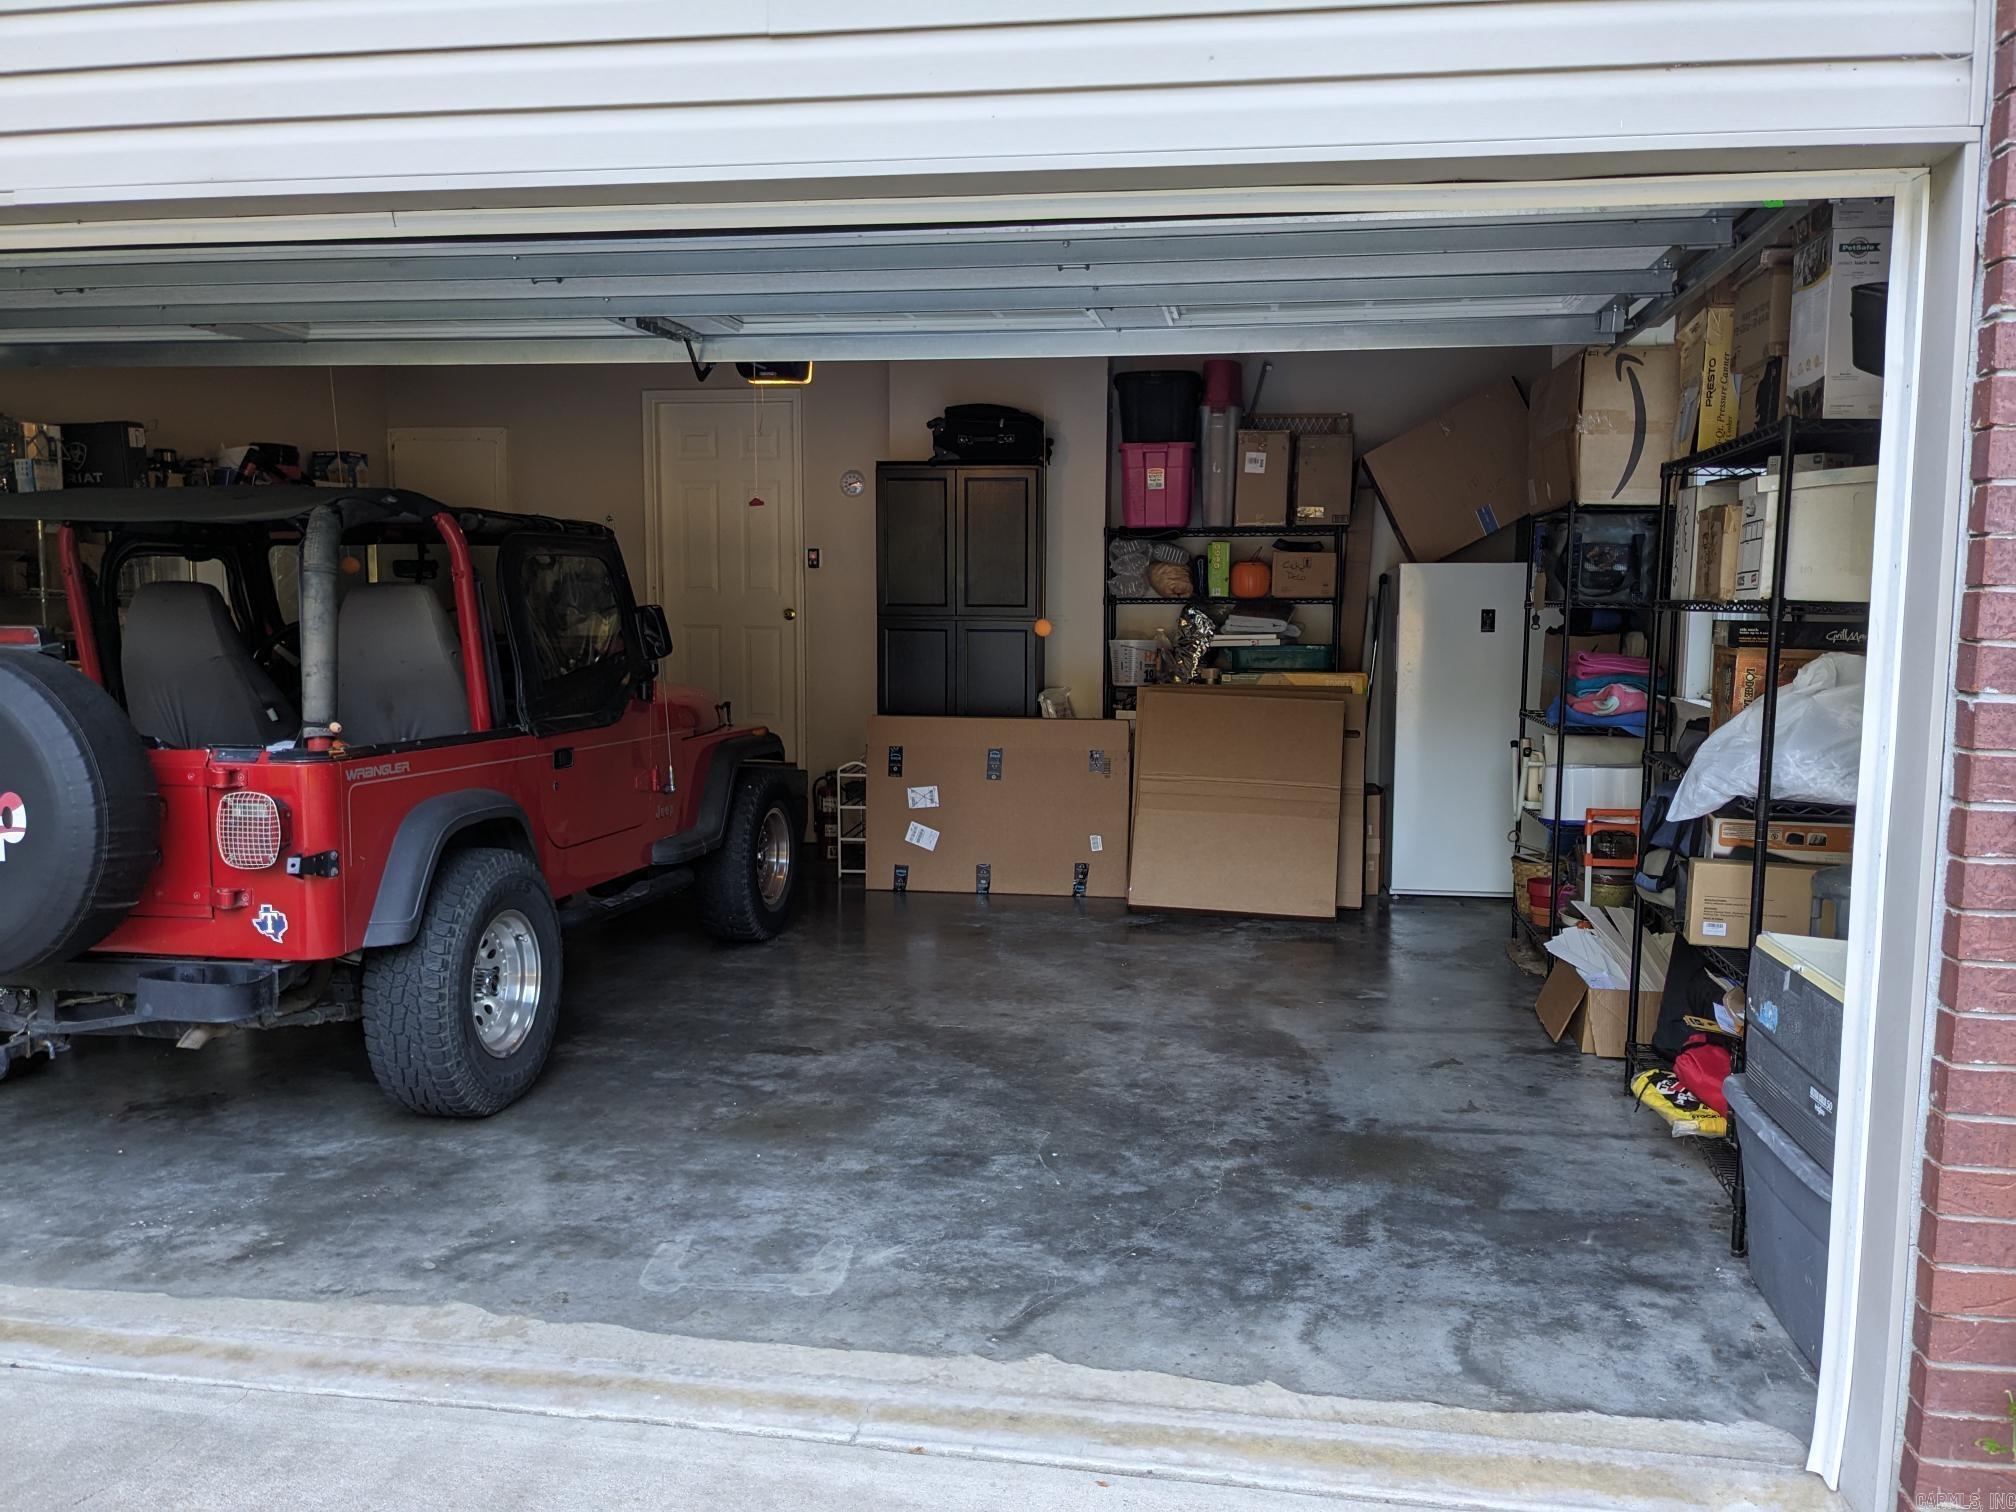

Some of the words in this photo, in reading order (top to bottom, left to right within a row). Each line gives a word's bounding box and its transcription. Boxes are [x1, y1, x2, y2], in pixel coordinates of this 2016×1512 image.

[1705, 358, 1716, 407] PRESTO
[1720, 352, 1731, 385] Canner
[1717, 386, 1728, 423] Pressure
[1745, 668, 1758, 698] LODGE
[345, 761, 410, 781] WRANGLER
